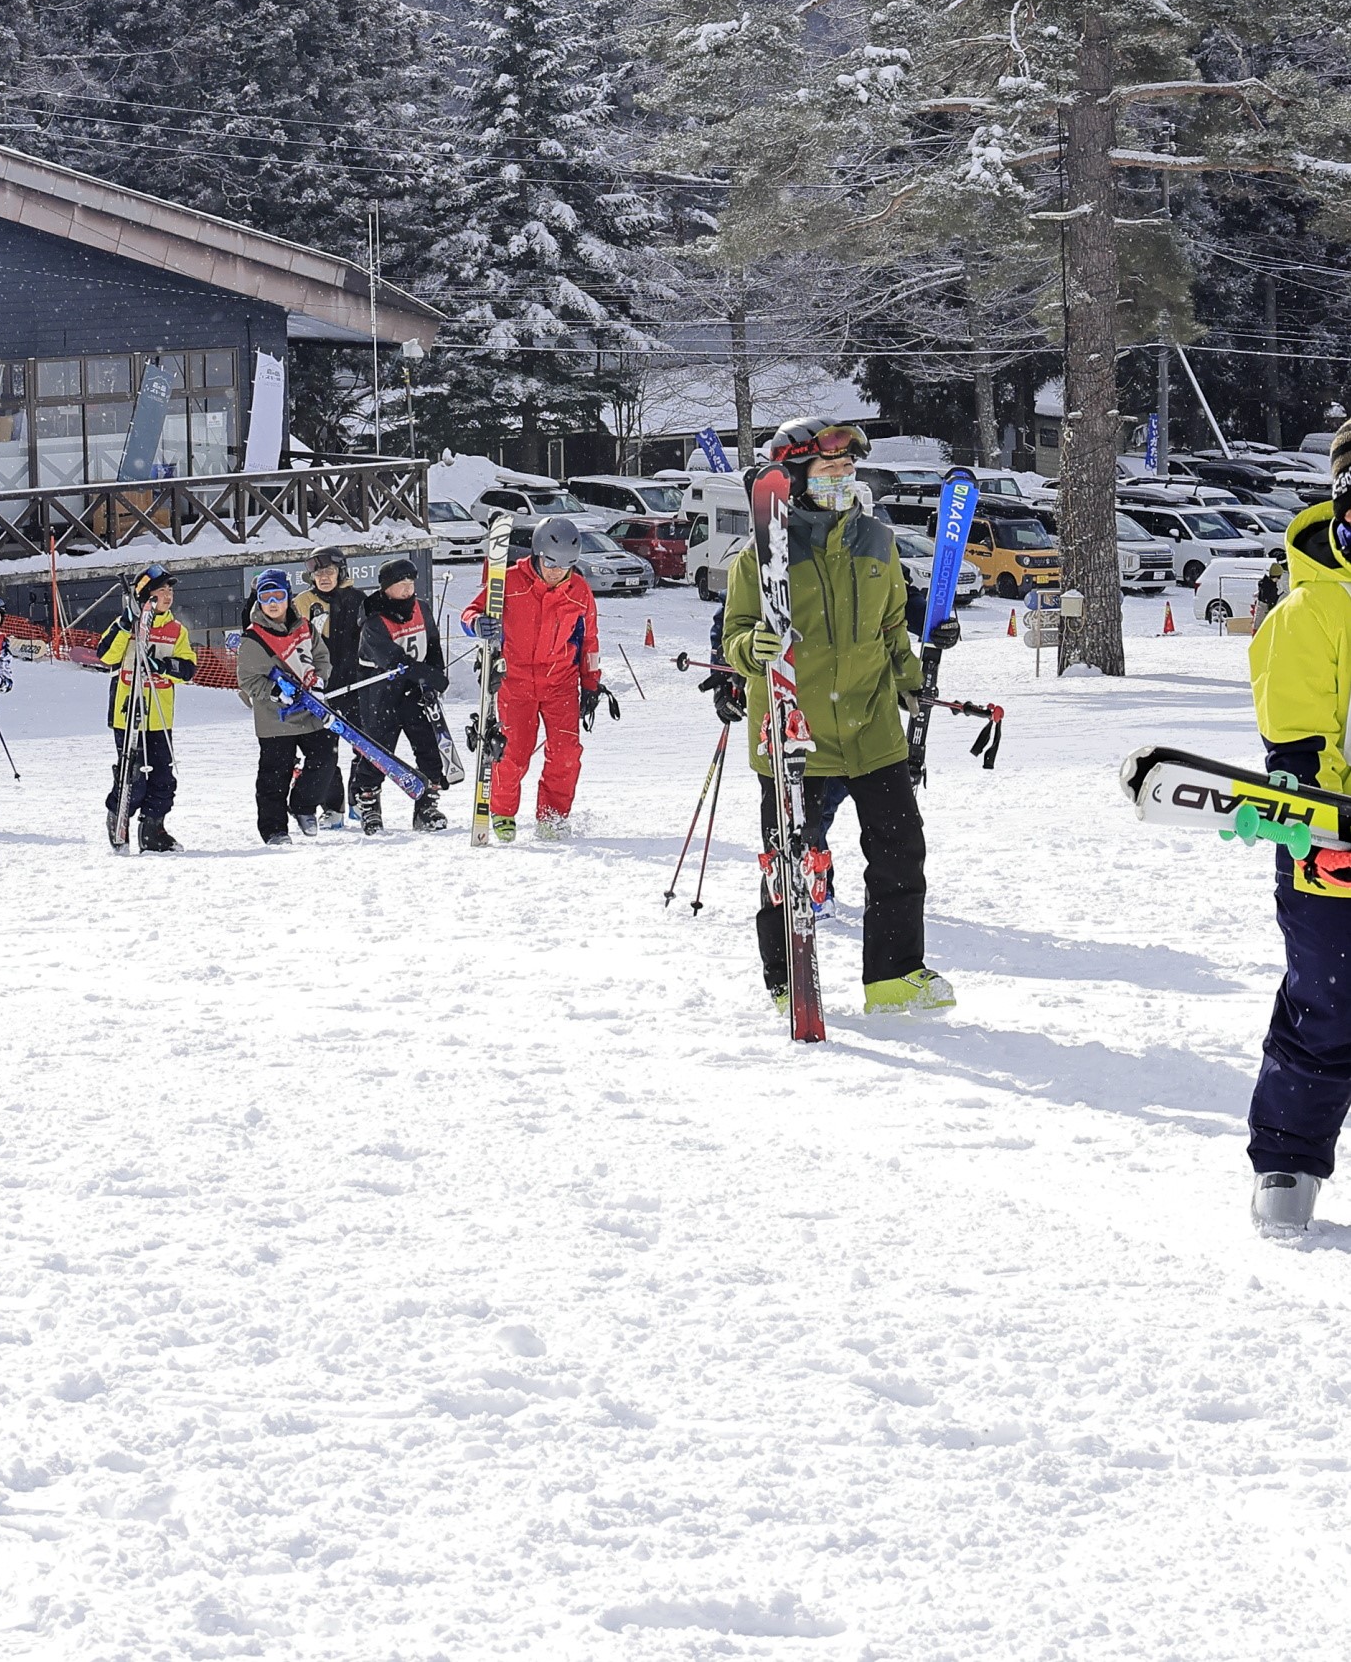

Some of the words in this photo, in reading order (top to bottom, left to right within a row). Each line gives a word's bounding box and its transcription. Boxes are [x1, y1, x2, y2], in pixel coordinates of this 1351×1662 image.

[347, 565, 377, 580] IRST
[936, 549, 954, 606] salomon
[406, 635, 419, 663] 5
[1171, 783, 1316, 828] HEAD
